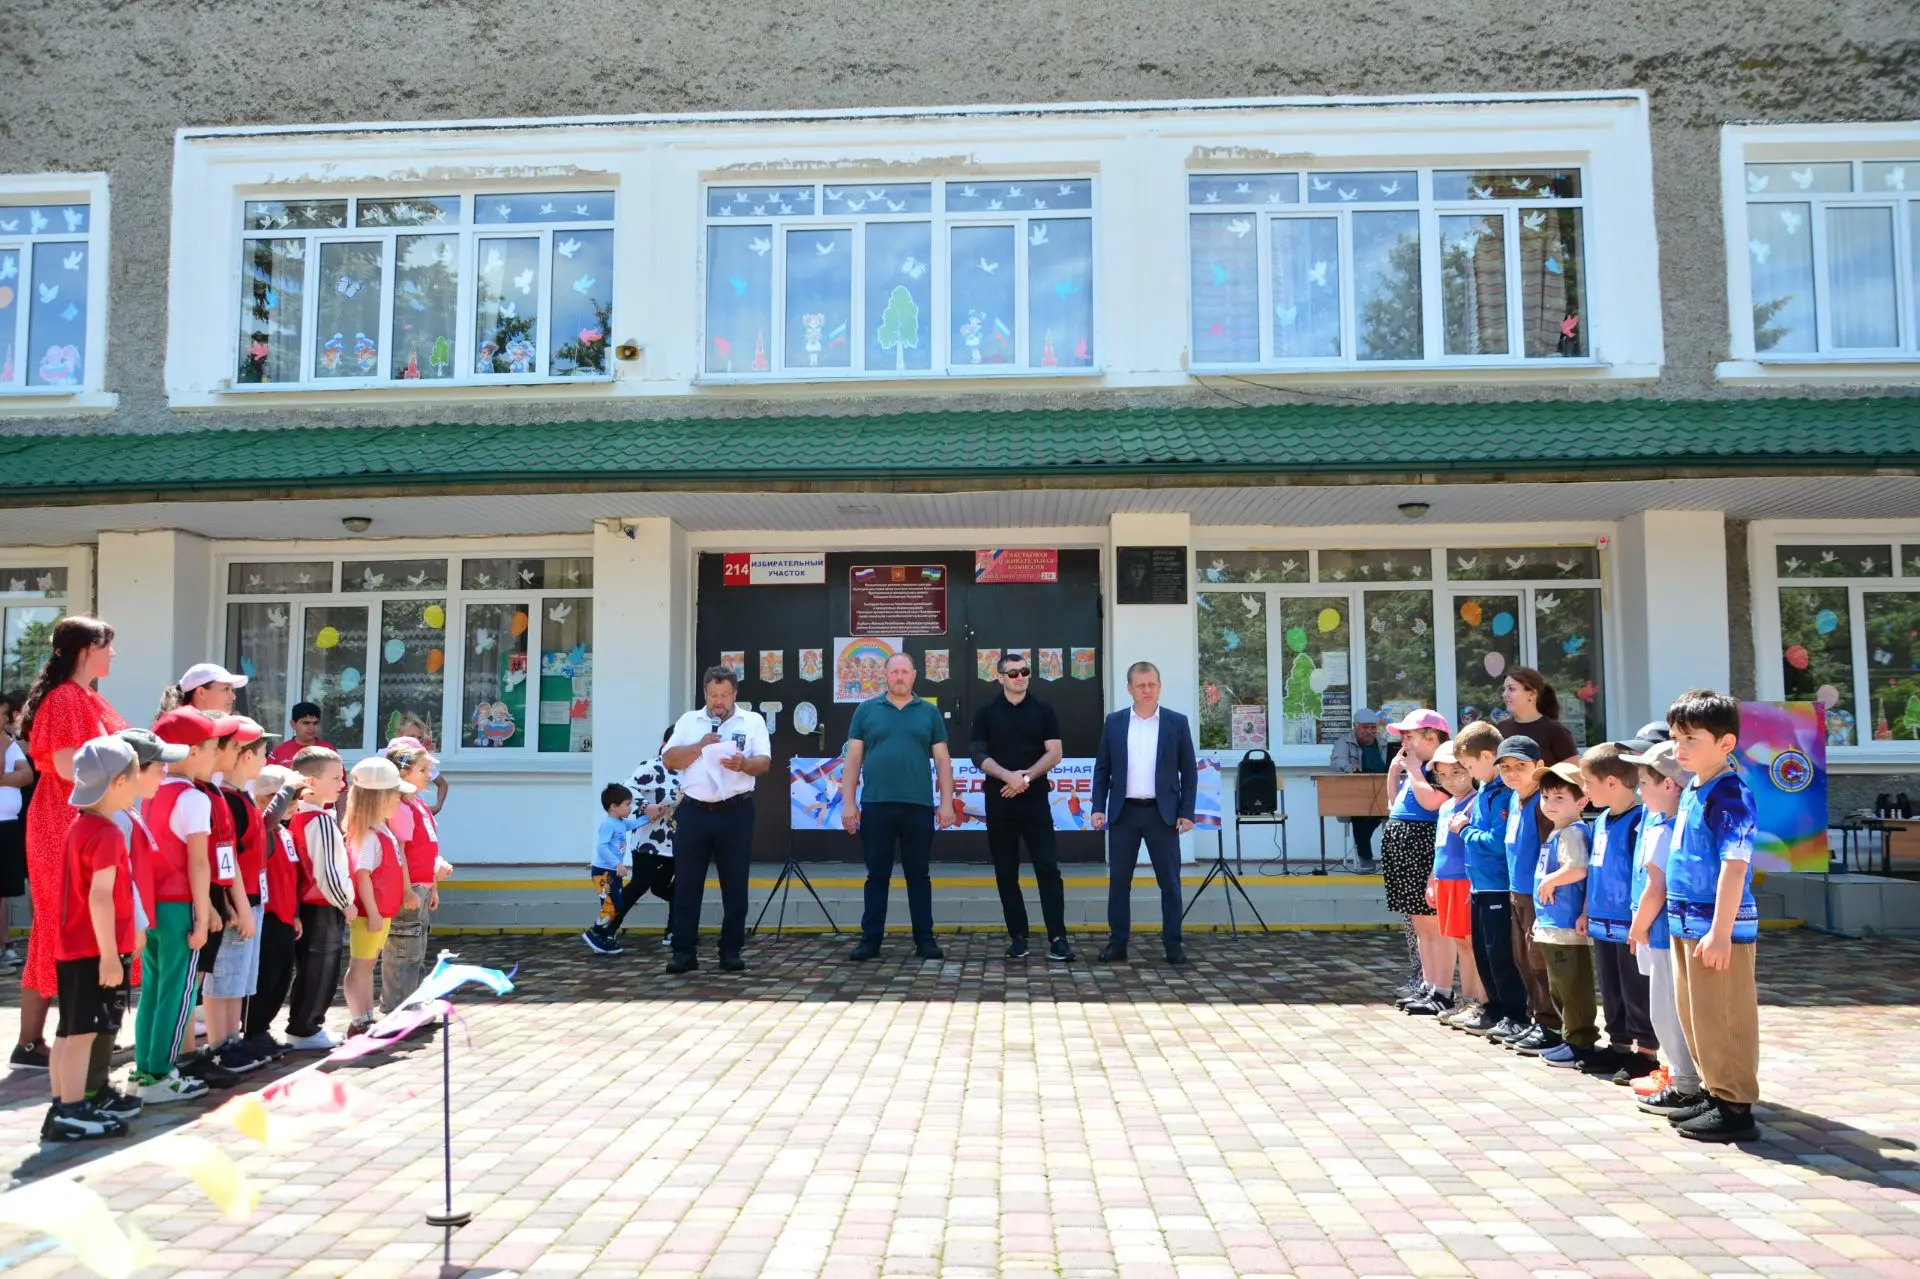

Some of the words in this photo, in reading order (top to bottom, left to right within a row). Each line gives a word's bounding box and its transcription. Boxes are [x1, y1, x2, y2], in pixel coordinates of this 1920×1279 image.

[725, 563, 749, 576] 214
[751, 558, 824, 567] ИЗБИРАТЕЛЬНЫЙ
[286, 839, 295, 857] 6
[221, 853, 232, 873] 4
[1539, 854, 1546, 872] 5
